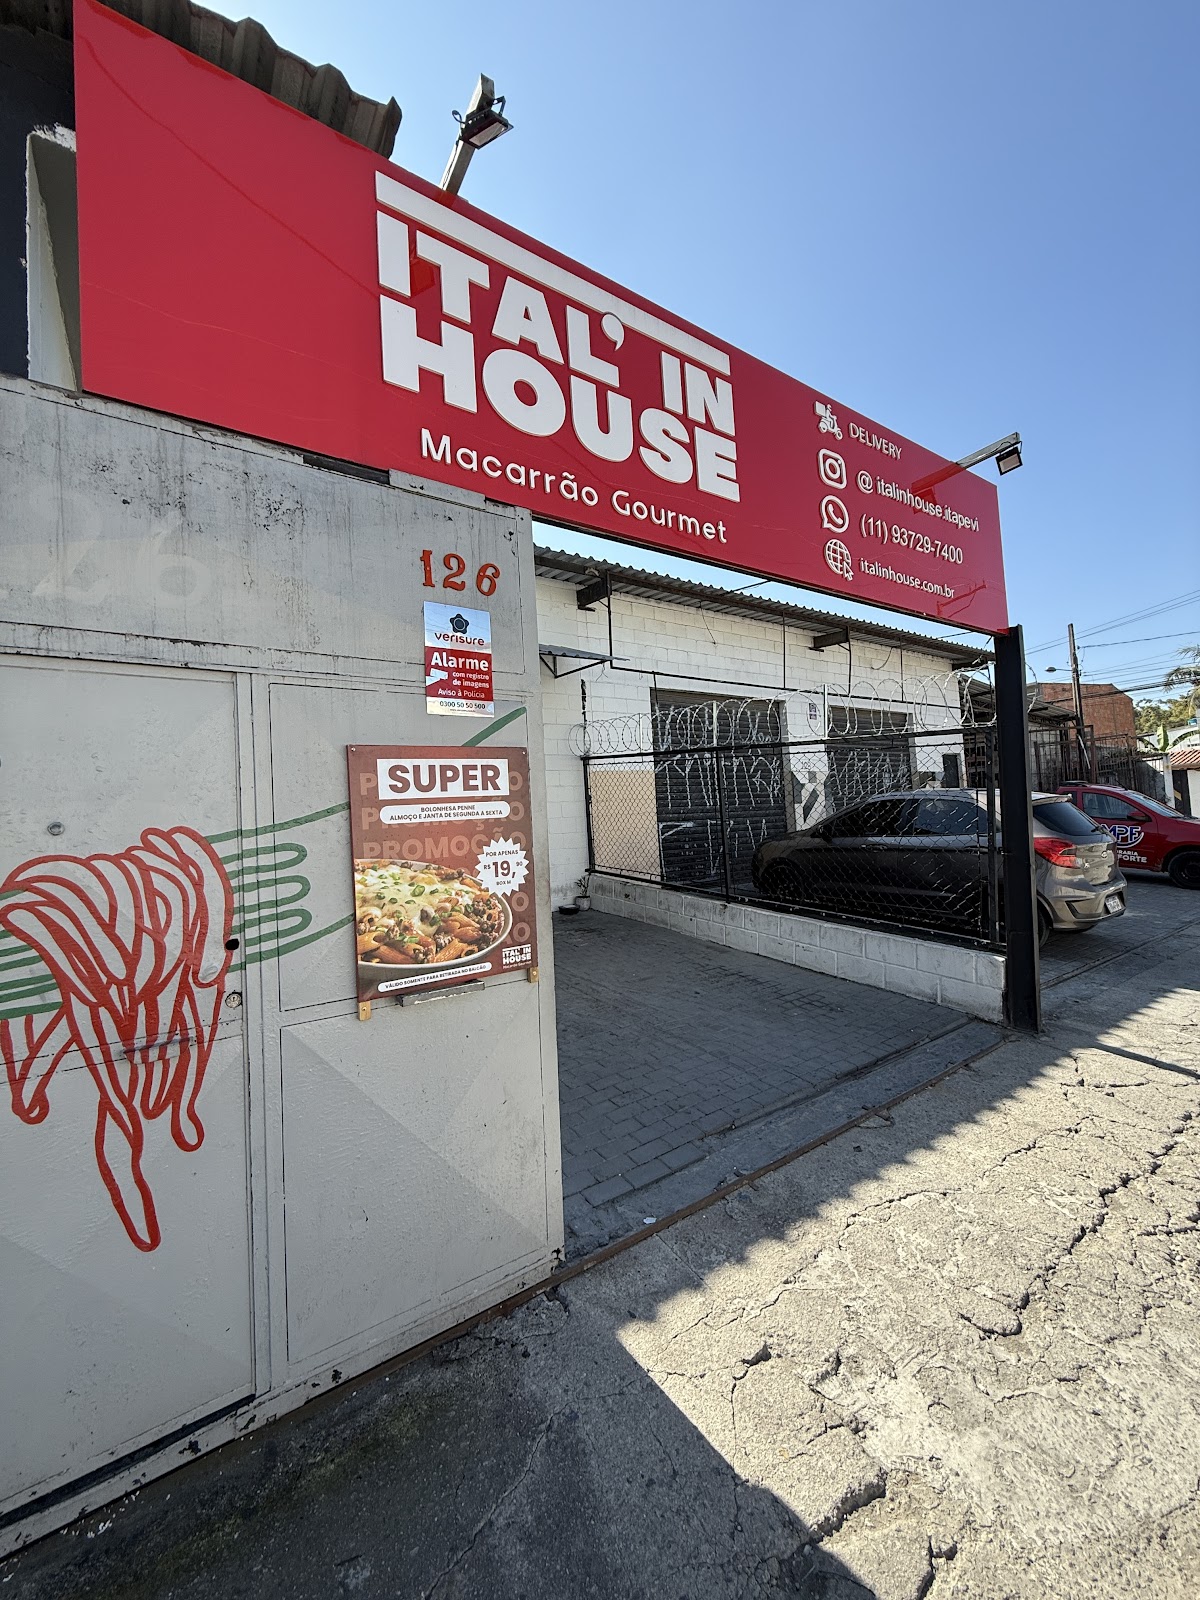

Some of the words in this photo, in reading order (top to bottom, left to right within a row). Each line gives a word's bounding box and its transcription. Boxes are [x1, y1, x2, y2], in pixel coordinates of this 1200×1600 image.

[379, 293, 741, 503] HOUSE
[660, 350, 736, 437] IN
[848, 422, 902, 461] DELIVERY
[420, 427, 600, 507] Macarrão
[611, 489, 728, 544] Gourmet
[876, 476, 980, 532] italinhouse.itapevi
[859, 513, 889, 544] (11)
[890, 525, 964, 565] 93729-7400
[420, 549, 501, 597] 126
[859, 557, 956, 599] italinhouse.com.br
[434, 631, 485, 646] verisure
[431, 651, 490, 671] Alarme
[462, 679, 490, 689] imagens
[466, 672, 490, 681] registro
[437, 688, 457, 697] Aviso
[387, 764, 502, 794] SUPER
[389, 813, 418, 822] ALMOÇO
[423, 811, 444, 820] JANTA
[452, 810, 480, 818] SEGUNDA
[420, 805, 457, 813] BOLONHESA
[502, 952, 532, 965] HOUSE
